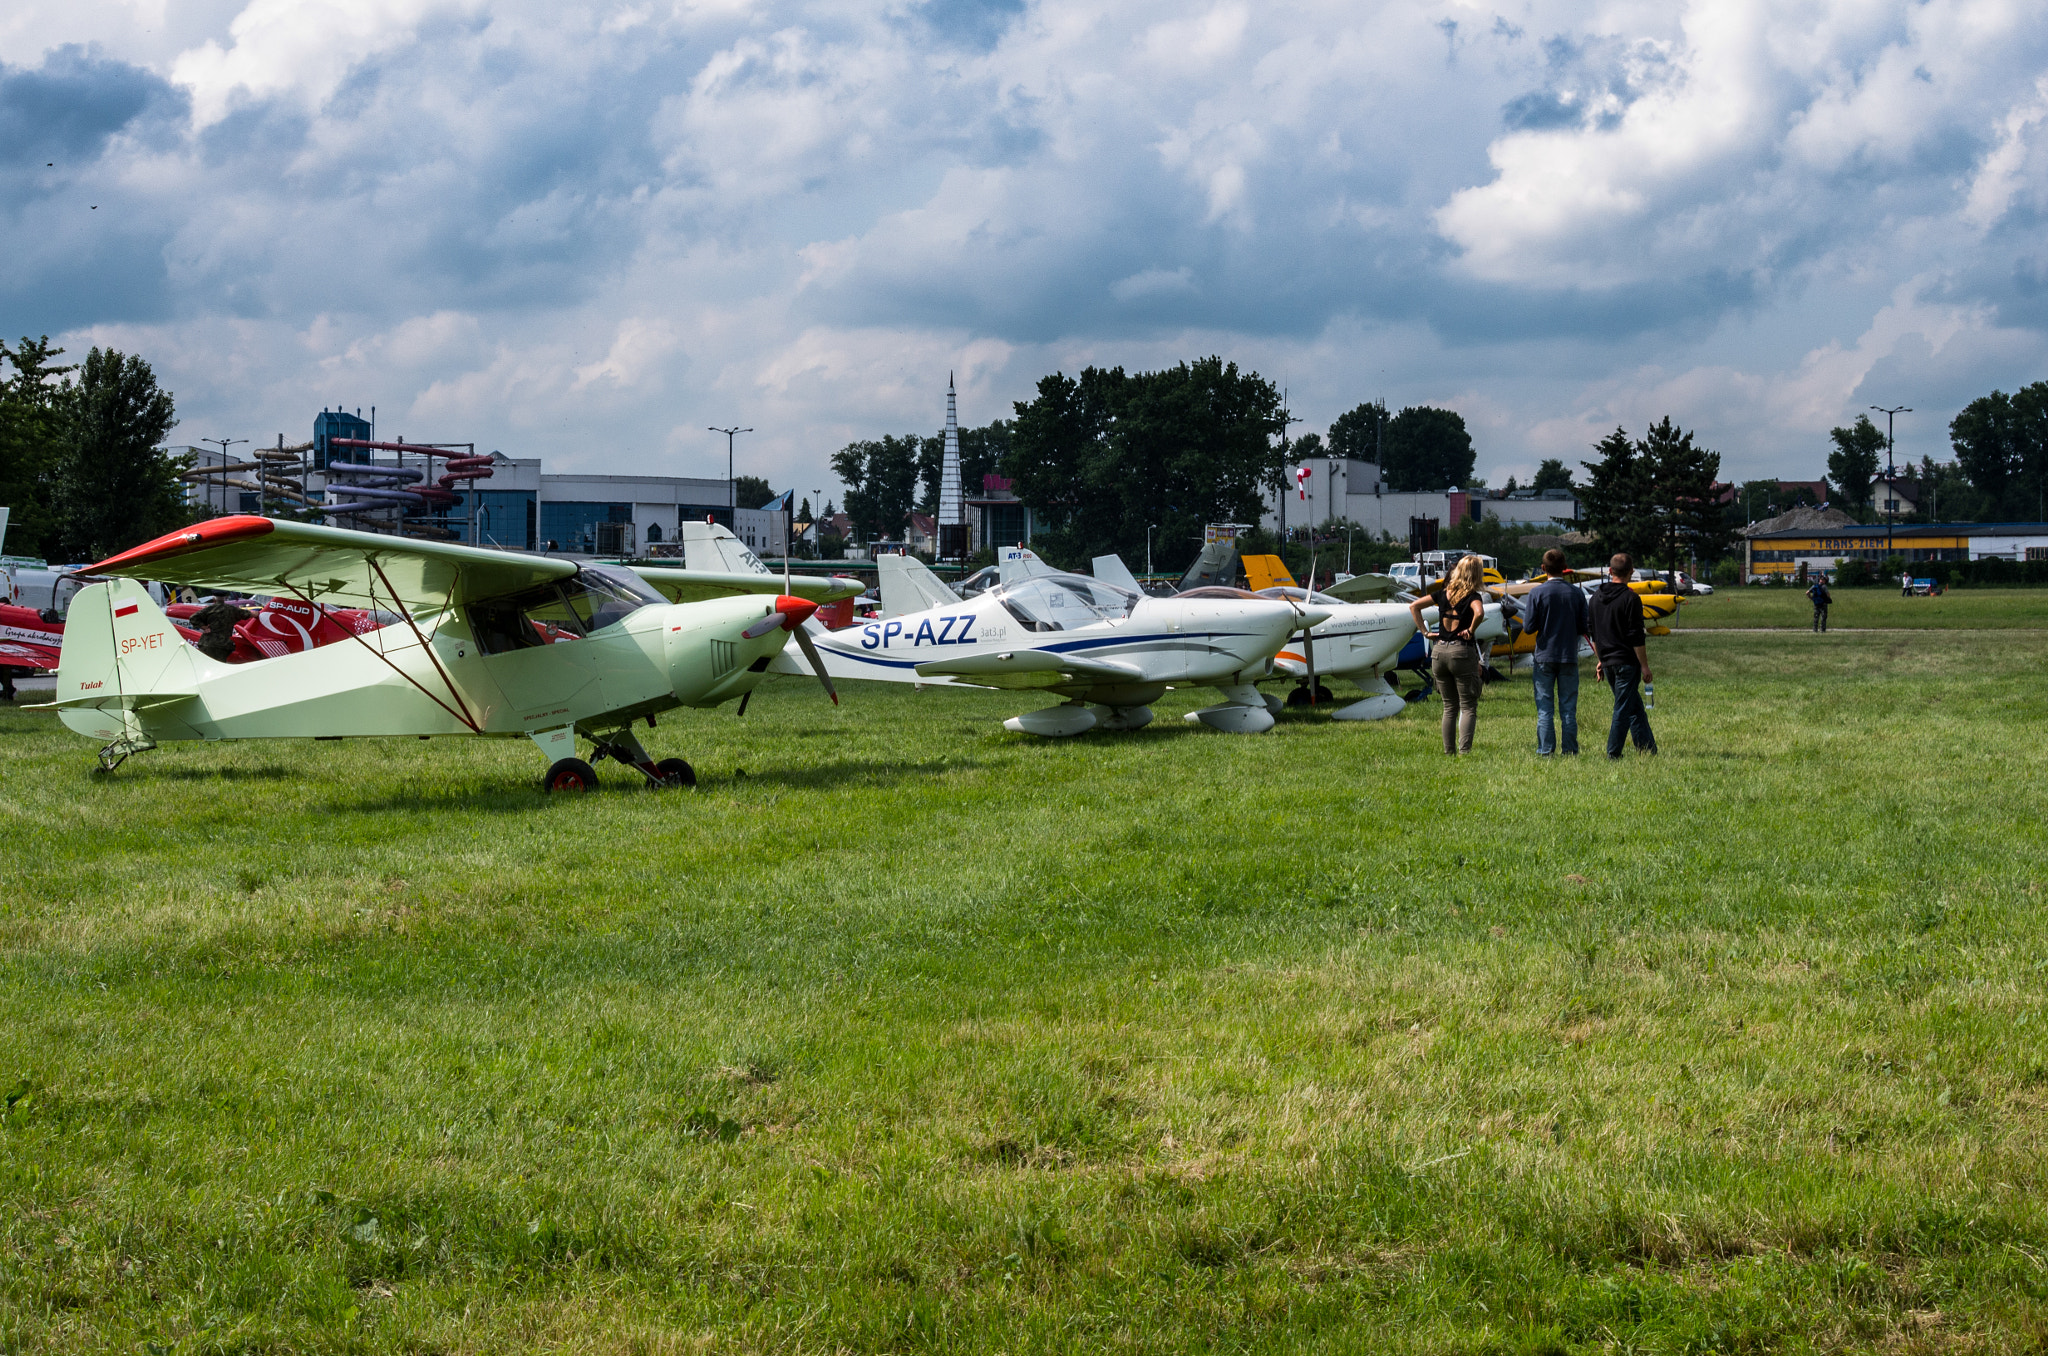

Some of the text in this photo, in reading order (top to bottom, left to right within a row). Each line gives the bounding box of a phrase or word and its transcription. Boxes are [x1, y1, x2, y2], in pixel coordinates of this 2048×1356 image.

[1818, 539, 1884, 549] TRANS-ZIEM
[1008, 552, 1022, 560] AT-3
[269, 601, 310, 615] SP-AUD
[861, 615, 1007, 649] SP-AZZ 3at3.pl
[121, 632, 165, 655] SP-YET
[80, 680, 104, 691] Tulak
